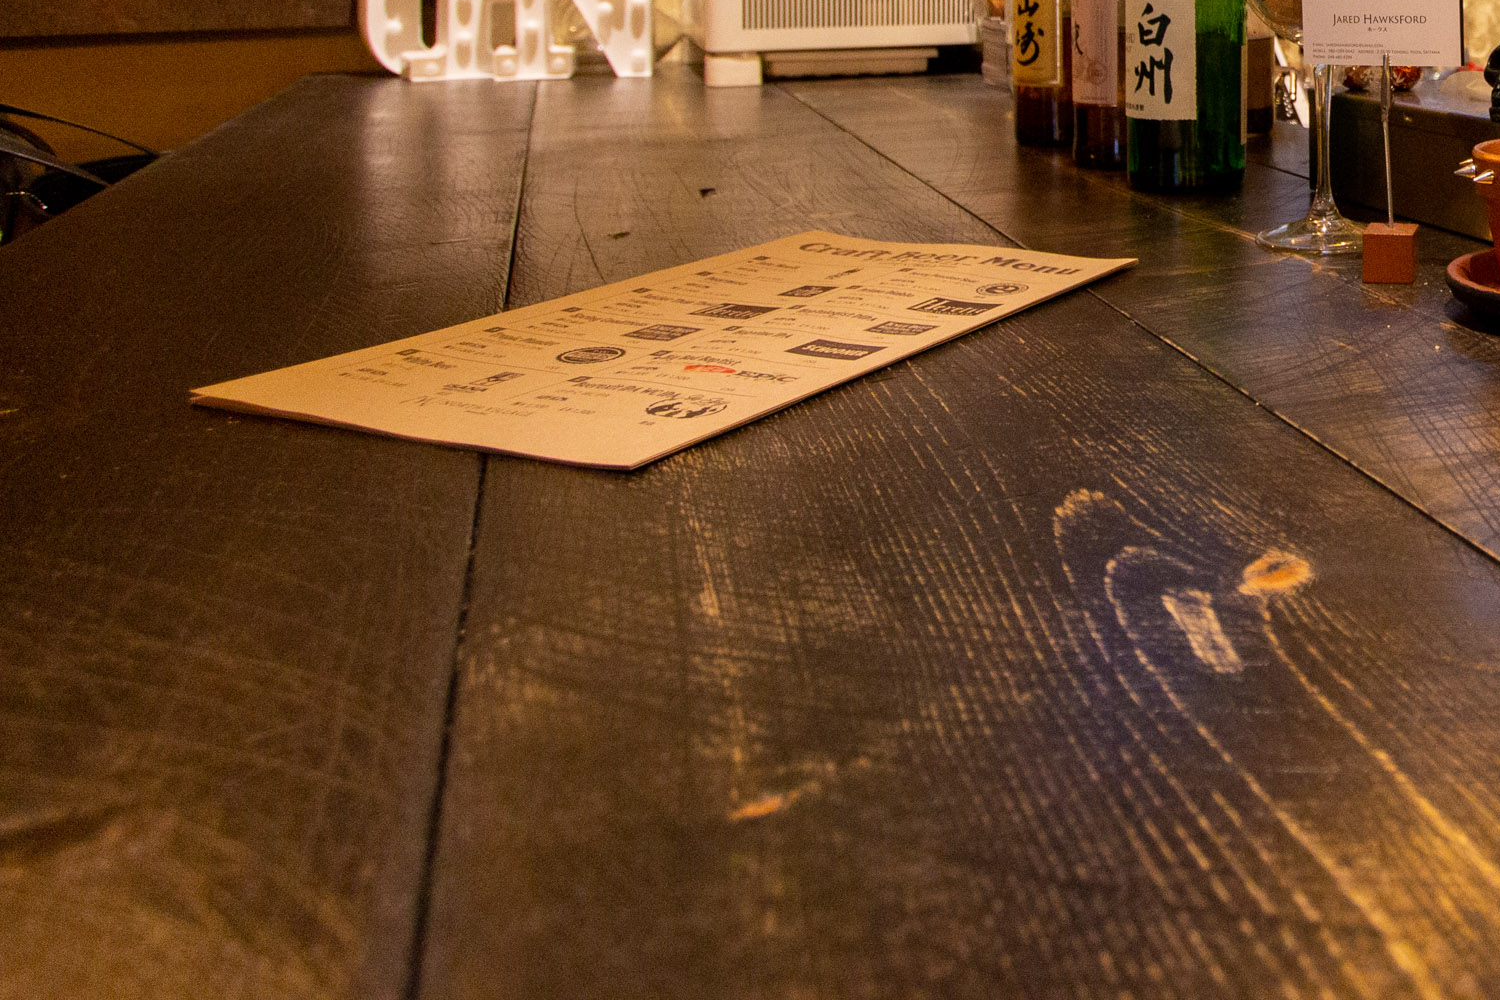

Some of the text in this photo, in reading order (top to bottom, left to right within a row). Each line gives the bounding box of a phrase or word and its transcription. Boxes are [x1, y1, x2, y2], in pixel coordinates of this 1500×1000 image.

[1333, 13, 1428, 26] JARED HAWKSFORD
[1134, 2, 1174, 104] 白州
[798, 241, 892, 263] Craft
[886, 250, 979, 264] Beer
[982, 255, 1082, 277] Menu
[801, 344, 870, 358] SCHOONER
